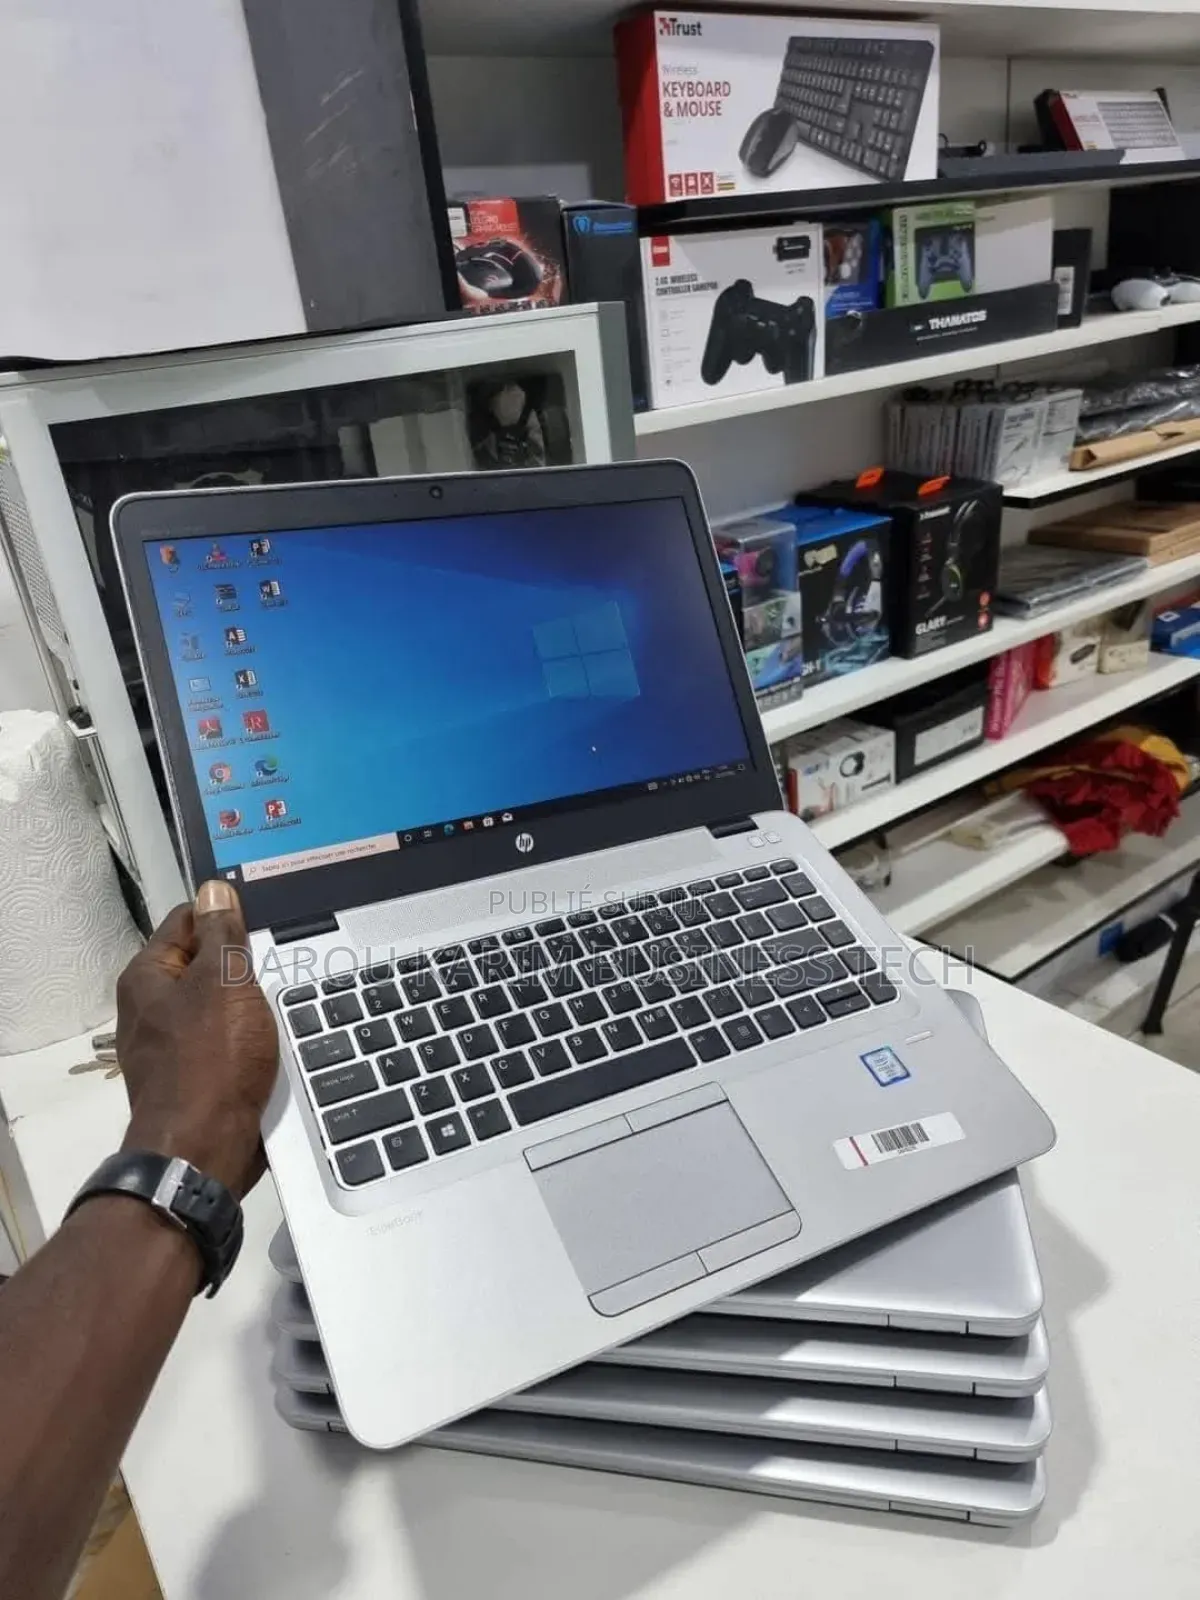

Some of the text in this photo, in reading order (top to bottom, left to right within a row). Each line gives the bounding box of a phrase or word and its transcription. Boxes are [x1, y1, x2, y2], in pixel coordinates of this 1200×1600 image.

[668, 18, 702, 36] Trust
[662, 81, 731, 98] KEYBOARD
[663, 101, 722, 118] & MOUSE
[928, 309, 987, 330] THANATOS
[516, 833, 534, 853] hp
[478, 993, 488, 1002] R
[574, 999, 584, 1009] H
[441, 1005, 450, 1014] E
[401, 1015, 413, 1025] W
[539, 1010, 549, 1020] G
[644, 1014, 655, 1023] M
[360, 1028, 371, 1037] Q
[463, 1033, 473, 1043] D
[572, 1037, 583, 1046] B
[425, 1046, 434, 1055] S
[536, 1048, 545, 1057] V
[385, 1058, 394, 1067] A
[498, 1060, 508, 1069] C
[461, 1072, 470, 1082] X
[419, 1085, 429, 1096] Z
